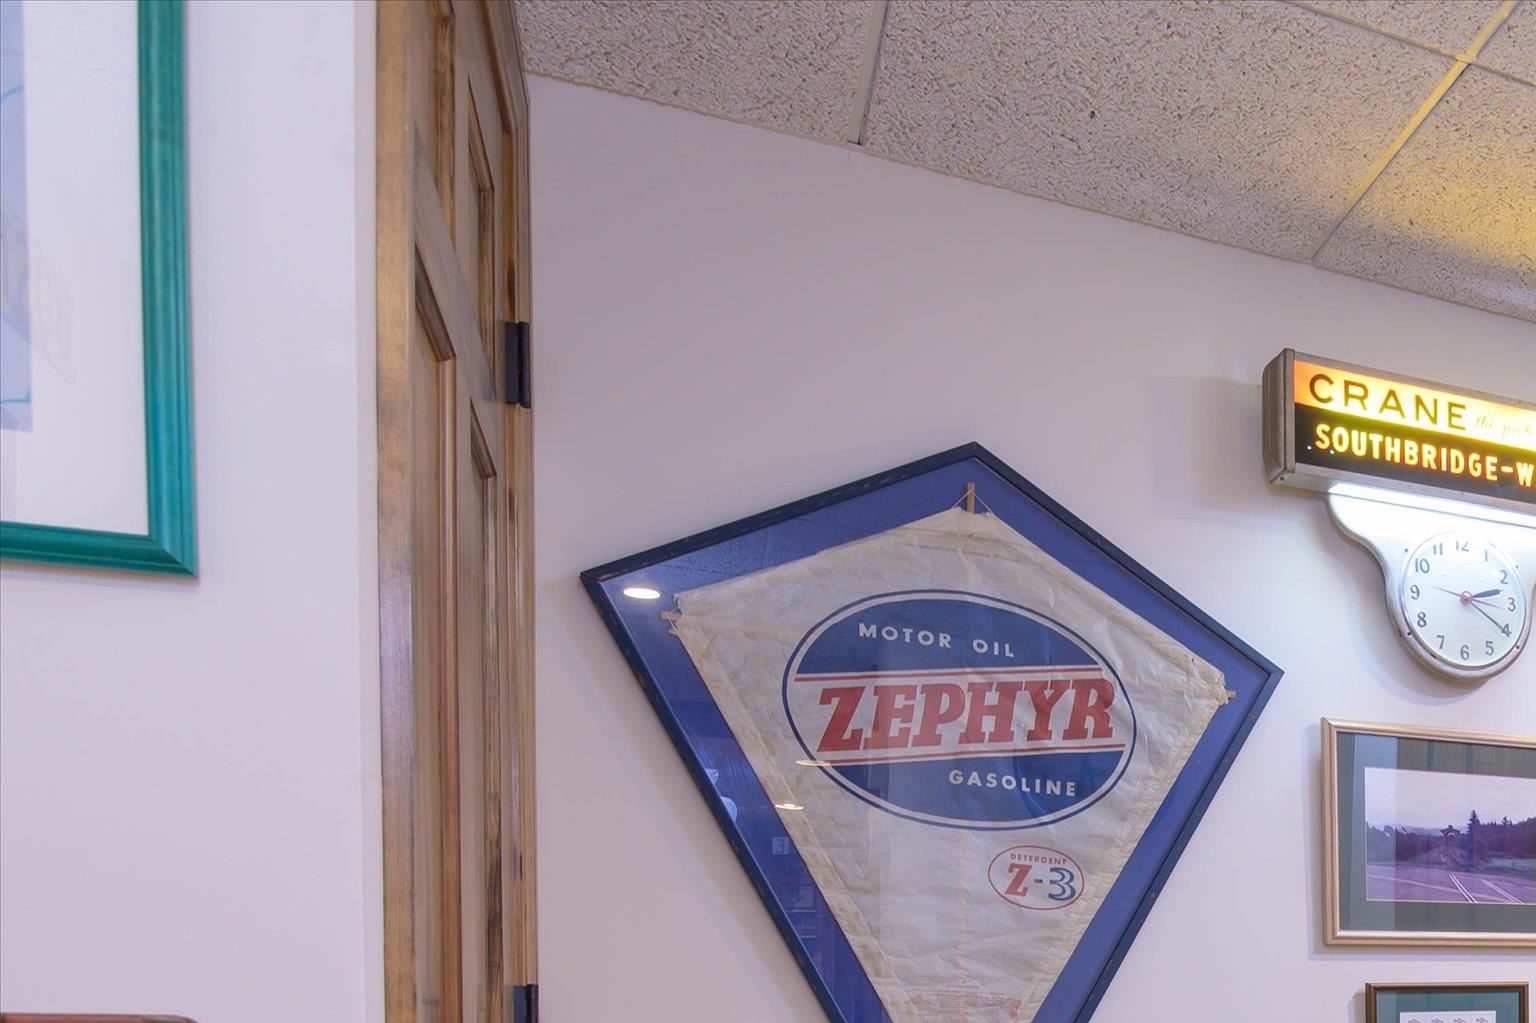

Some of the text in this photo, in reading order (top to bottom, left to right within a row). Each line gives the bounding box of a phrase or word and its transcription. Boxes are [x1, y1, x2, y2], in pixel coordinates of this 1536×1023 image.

[1309, 373, 1468, 432] CRANE
[1433, 542, 1443, 556] 11
[1455, 540, 1470, 552] 12
[1414, 558, 1430, 573] 10
[1499, 570, 1509, 584] 2
[1410, 584, 1420, 600] 9
[1507, 597, 1516, 612] 3
[1417, 611, 1427, 628] 8
[1501, 623, 1512, 638] 4
[858, 622, 1015, 658] MOTOR OIL
[1436, 634, 1445, 650] 7
[1460, 644, 1470, 661] 6
[1485, 641, 1494, 656] 5
[816, 677, 1116, 753] ZEPHYR
[948, 770, 1077, 797] GASOLINE
[1010, 853, 1067, 866] DETERGENT
[1004, 863, 1076, 902] Z-3
